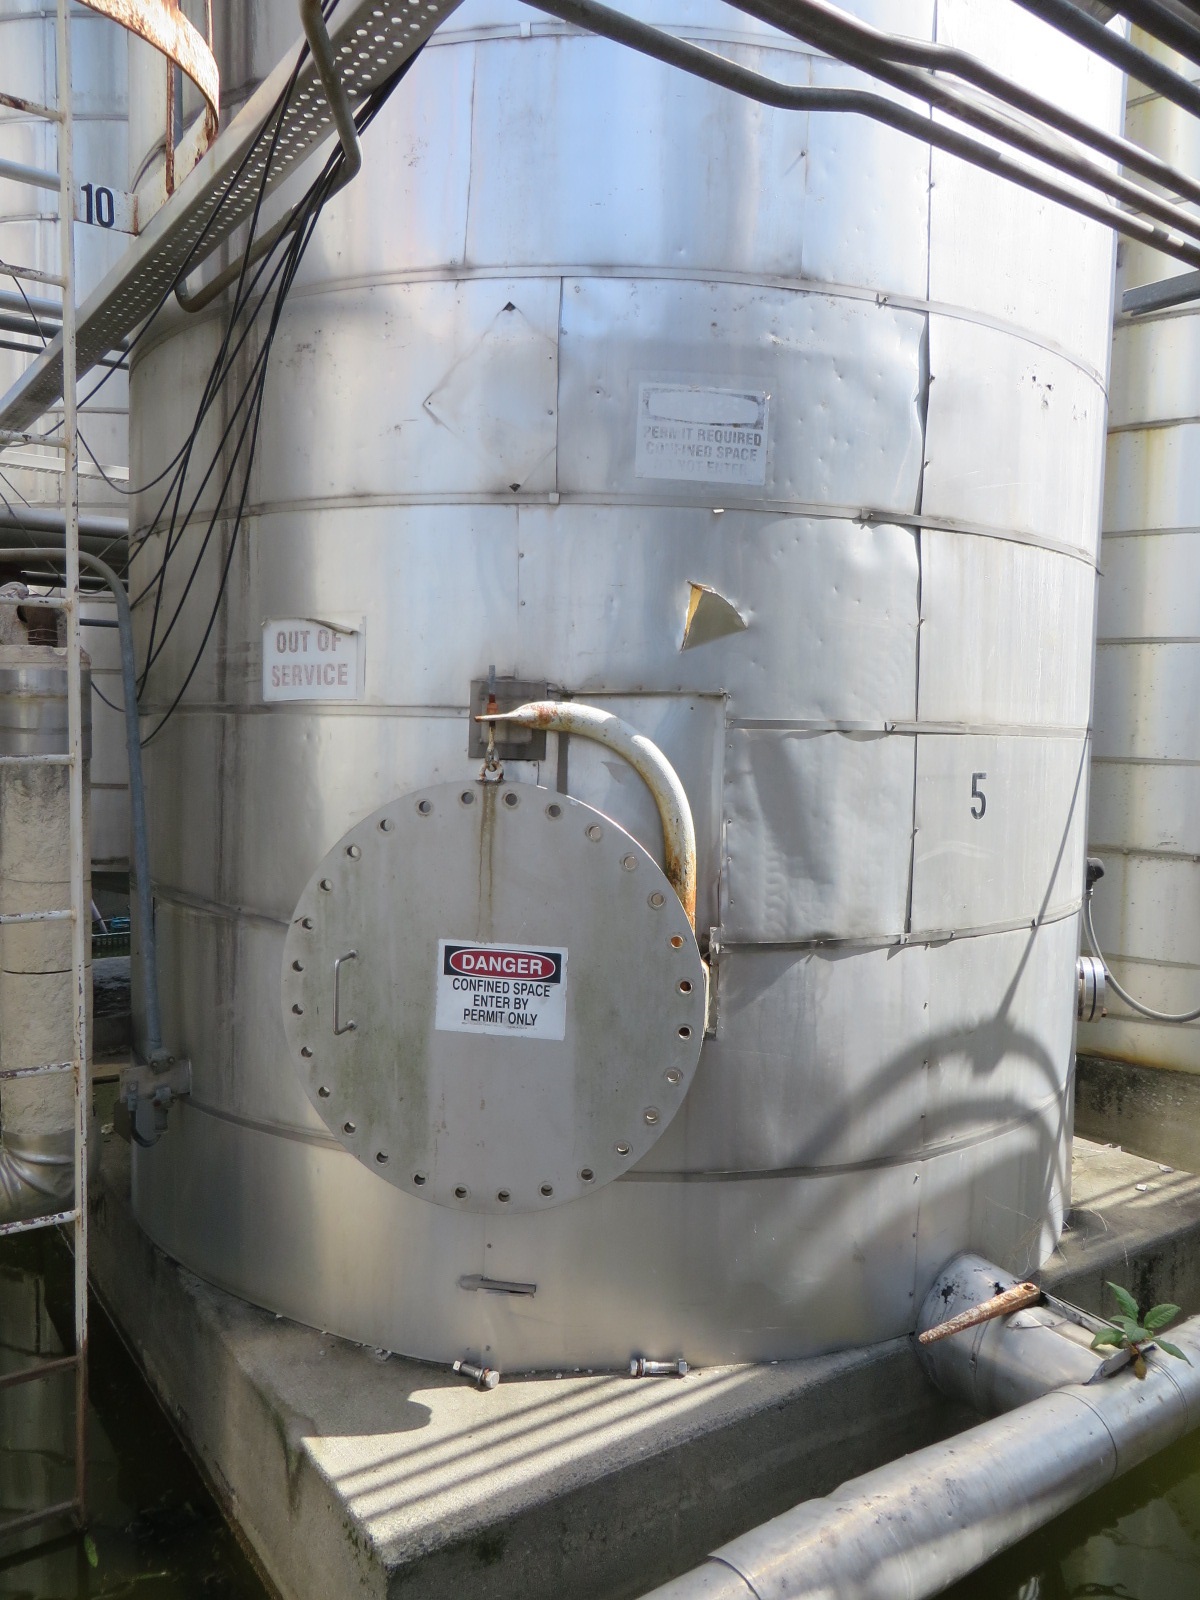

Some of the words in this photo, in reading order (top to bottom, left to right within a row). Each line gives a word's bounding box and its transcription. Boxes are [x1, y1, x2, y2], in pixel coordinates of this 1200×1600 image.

[81, 183, 114, 228] 10
[697, 428, 762, 447] REQUIRED
[716, 445, 758, 462] SPACE
[276, 630, 311, 653] OUT
[317, 629, 342, 652] OF
[271, 663, 348, 688] SERVICE
[970, 772, 987, 820] 5
[461, 954, 543, 975] DANGER
[452, 977, 510, 994] CONFINED
[513, 982, 551, 997] SPACE
[473, 994, 511, 1009] ENTER
[513, 997, 529, 1011] BY
[463, 1008, 505, 1023] PERMIT
[507, 1011, 538, 1026] ONLY
